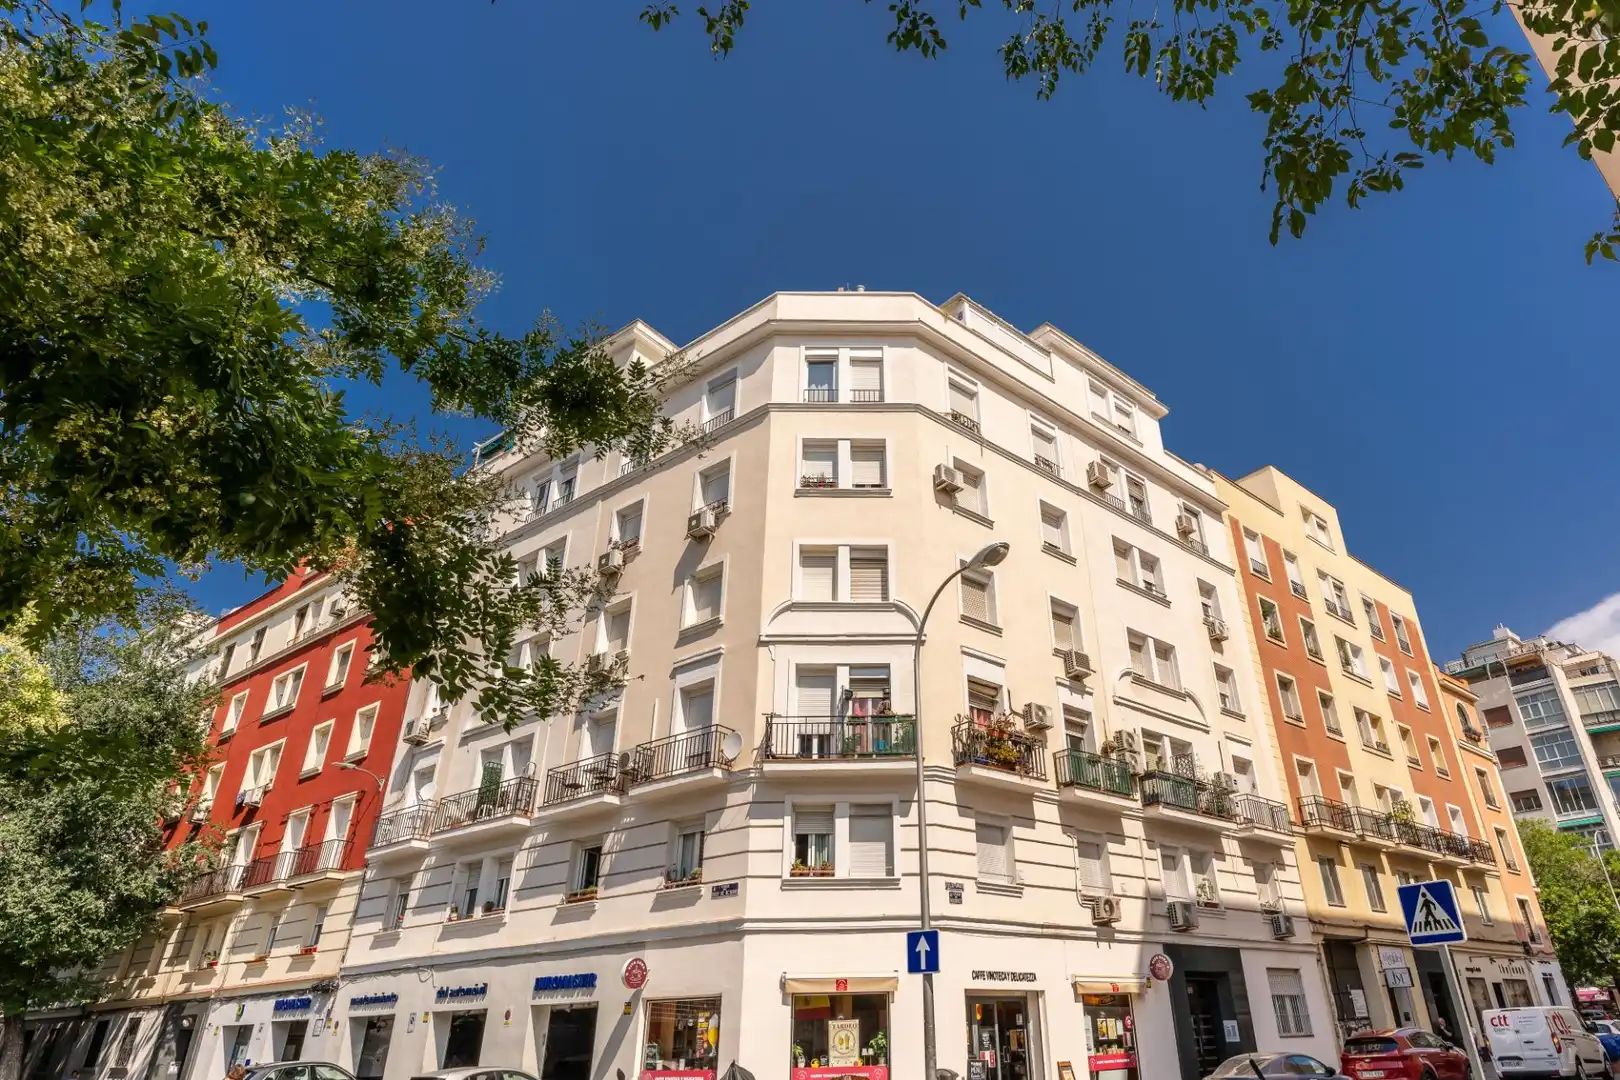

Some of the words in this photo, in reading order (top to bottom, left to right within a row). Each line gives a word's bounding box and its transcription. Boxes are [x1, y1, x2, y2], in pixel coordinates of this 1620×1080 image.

[972, 969, 986, 981] CAFFE
[986, 970, 1007, 981] VINOTECA
[1011, 971, 1037, 983] DELICATEZZA
[1490, 1014, 1510, 1027] ctt
